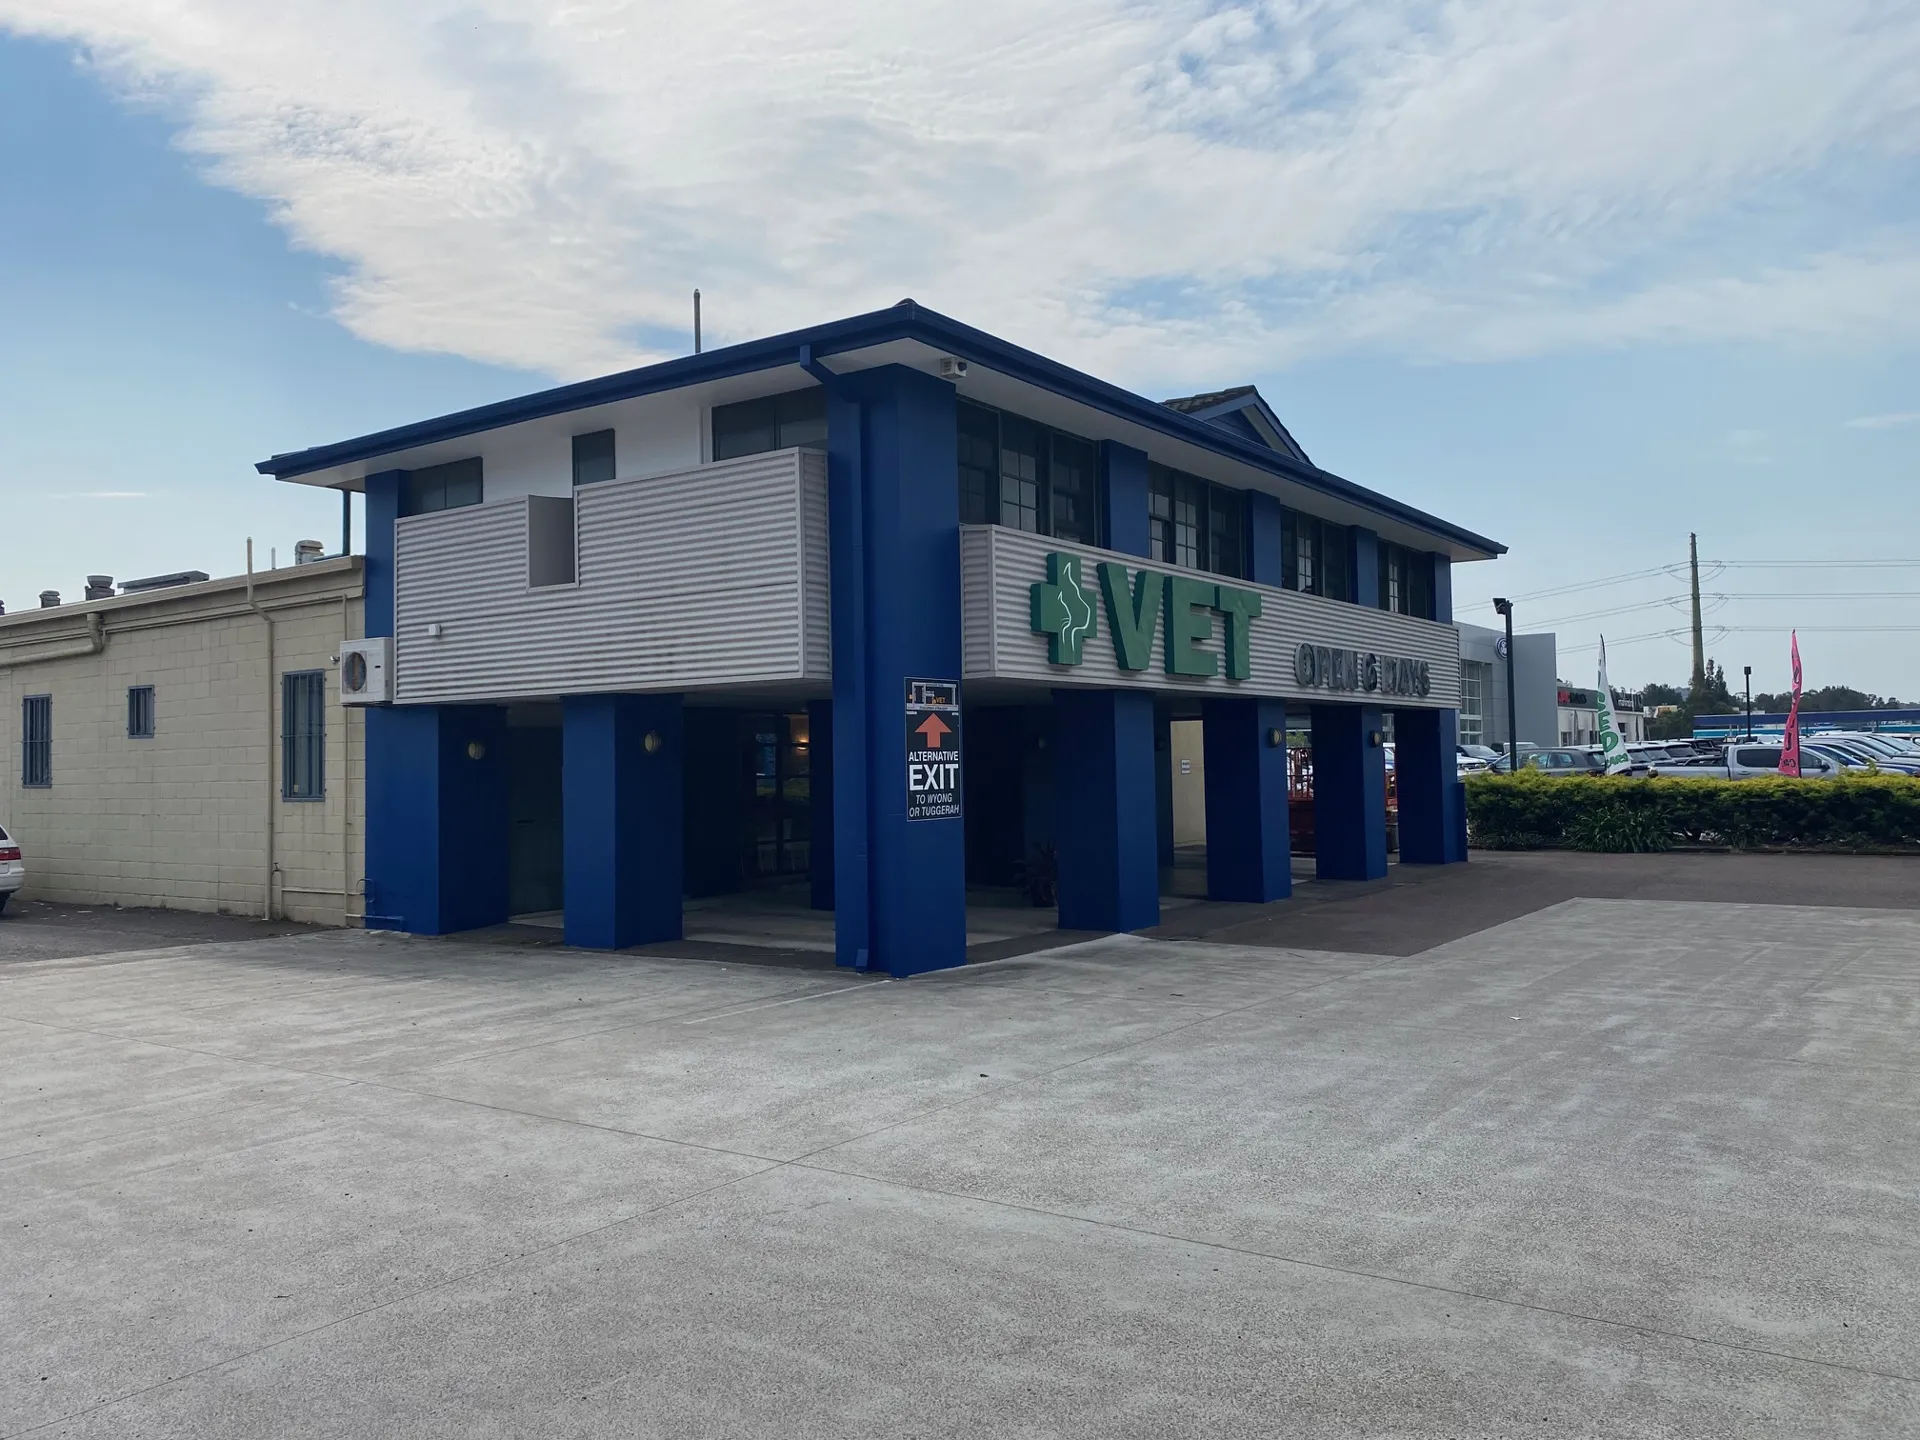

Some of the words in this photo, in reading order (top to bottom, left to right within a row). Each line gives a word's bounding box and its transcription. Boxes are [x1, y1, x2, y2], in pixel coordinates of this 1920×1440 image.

[1097, 562, 1262, 680] VET
[1294, 643, 1359, 691] OPEN
[1362, 653, 1378, 692] 6
[1381, 655, 1431, 697] DAYS
[908, 751, 959, 762] ALTERNATIVE
[909, 763, 959, 791] EXIT
[916, 794, 926, 805] TO
[927, 792, 953, 804] WYONG
[909, 807, 920, 817] OR
[921, 804, 959, 816] TUGGERAH
